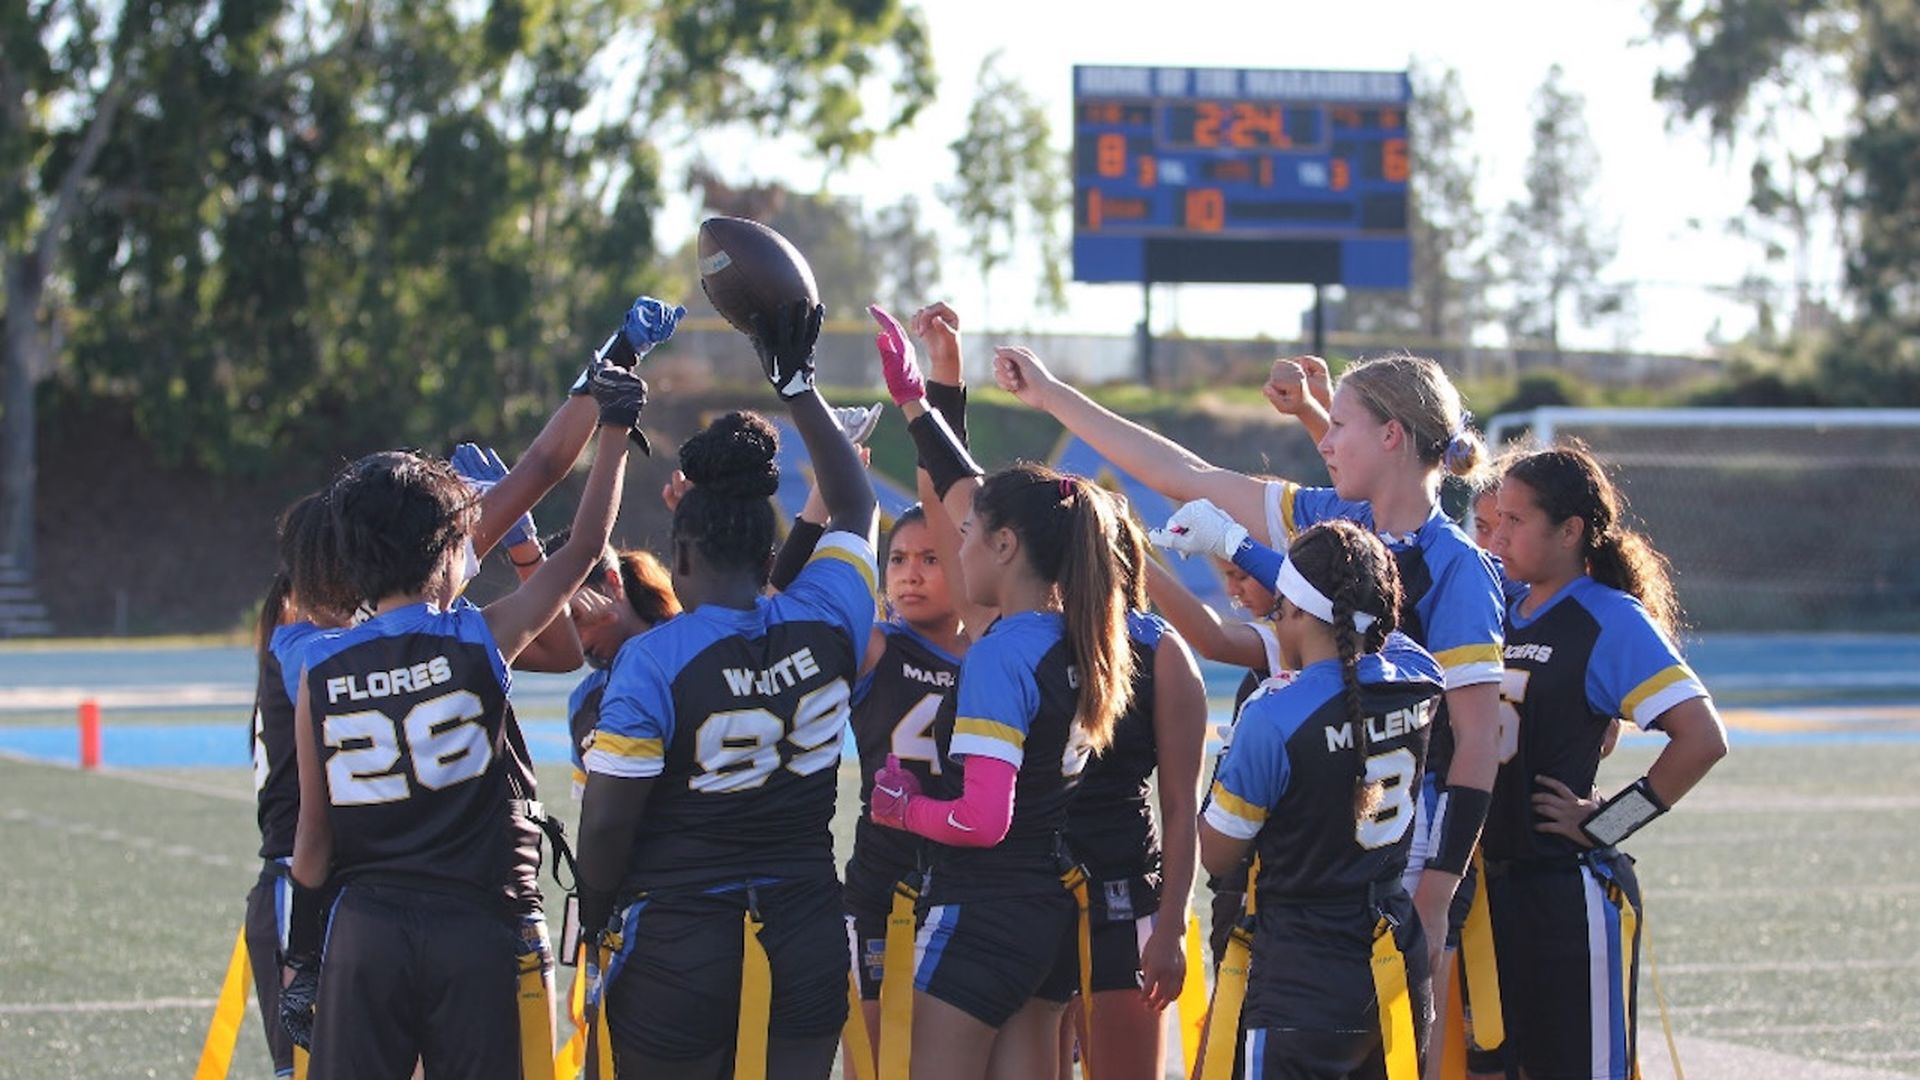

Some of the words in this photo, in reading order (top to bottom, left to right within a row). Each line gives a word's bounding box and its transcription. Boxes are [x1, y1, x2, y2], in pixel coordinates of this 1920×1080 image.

[1097, 133, 1127, 177] 8
[1382, 138, 1410, 182] 6
[1185, 189, 1224, 232] 10
[326, 655, 452, 704] FLORES
[723, 647, 821, 697] WHITE
[323, 689, 493, 807] 26
